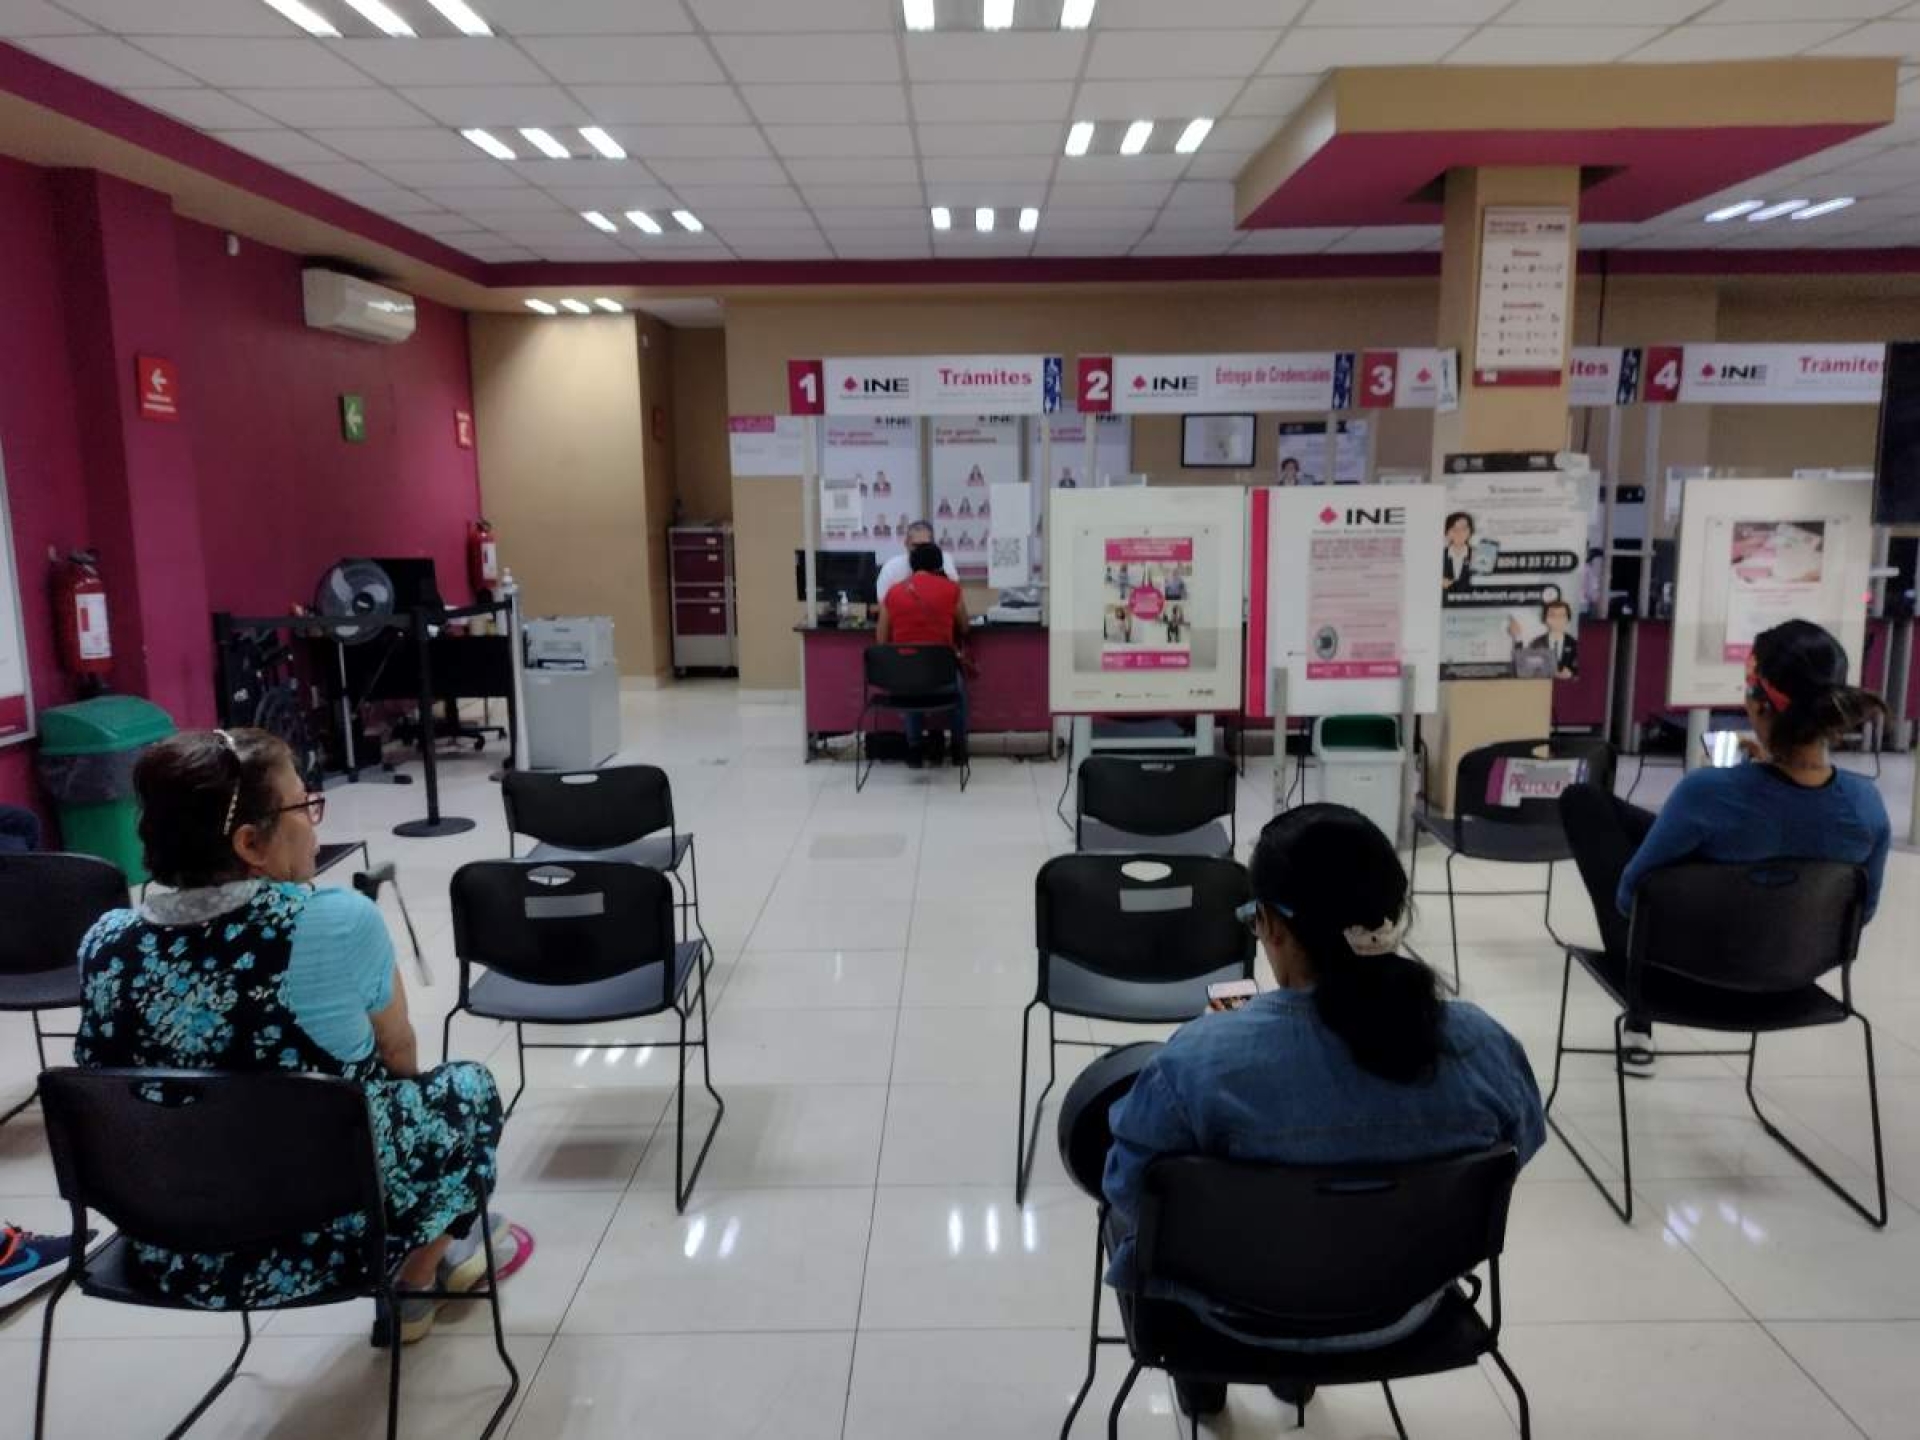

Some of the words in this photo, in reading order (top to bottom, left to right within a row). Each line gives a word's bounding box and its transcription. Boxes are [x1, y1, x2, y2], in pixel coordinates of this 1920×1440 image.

[1569, 359, 1609, 377] ites
[1721, 364, 1768, 380] INE
[1798, 356, 1884, 374] Trámite
[938, 368, 1033, 387] Trámites
[1152, 376, 1198, 391] INE
[1215, 367, 1252, 386] Entrega
[1256, 367, 1267, 383] de
[1269, 365, 1332, 383] Credenciales
[1369, 365, 1393, 395] 3
[1652, 360, 1679, 391] 4
[799, 373, 817, 404] 1
[863, 378, 909, 393] INE
[1085, 370, 1110, 400] 2
[1346, 507, 1406, 525] INE
